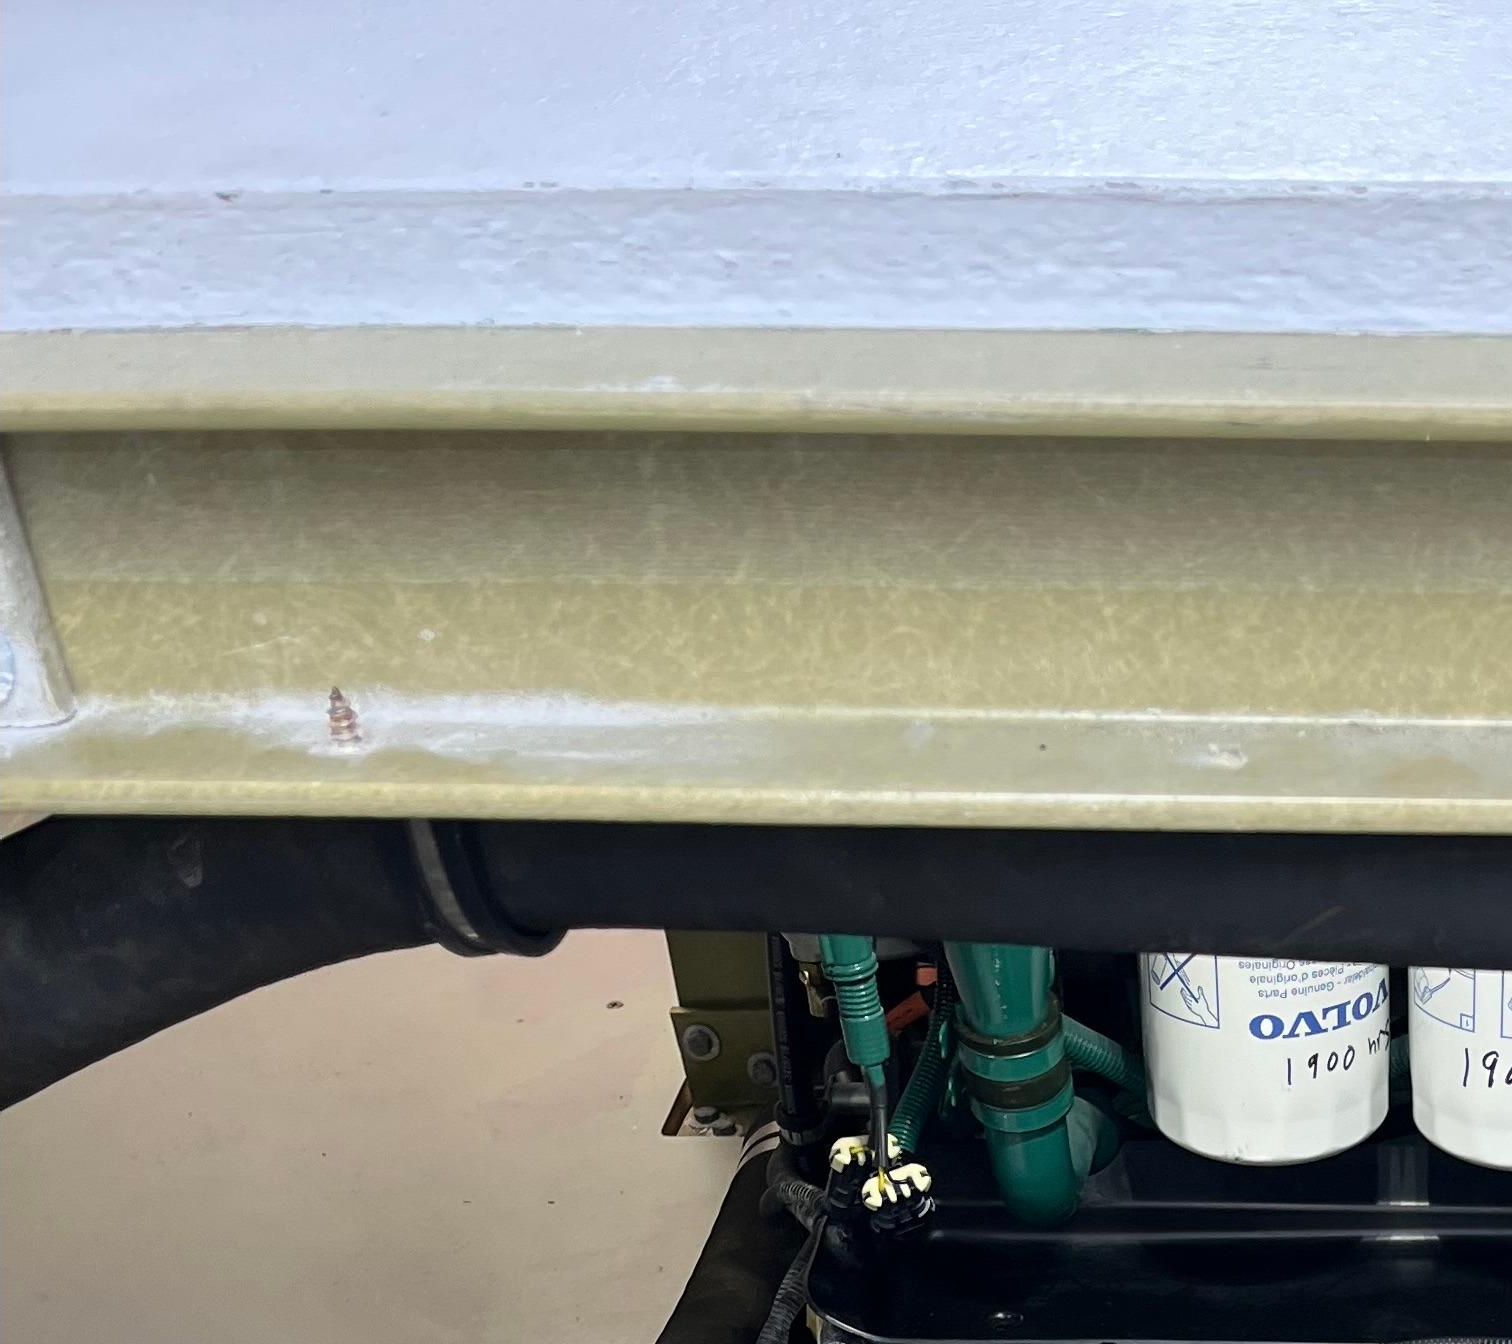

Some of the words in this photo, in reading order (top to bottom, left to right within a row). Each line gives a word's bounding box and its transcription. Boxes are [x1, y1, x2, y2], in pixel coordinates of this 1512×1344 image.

[1258, 988, 1287, 998] Parts
[1292, 981, 1334, 995] Genuine
[1249, 978, 1388, 1040] VOLVO
[1287, 1045, 1356, 1086] 1900
